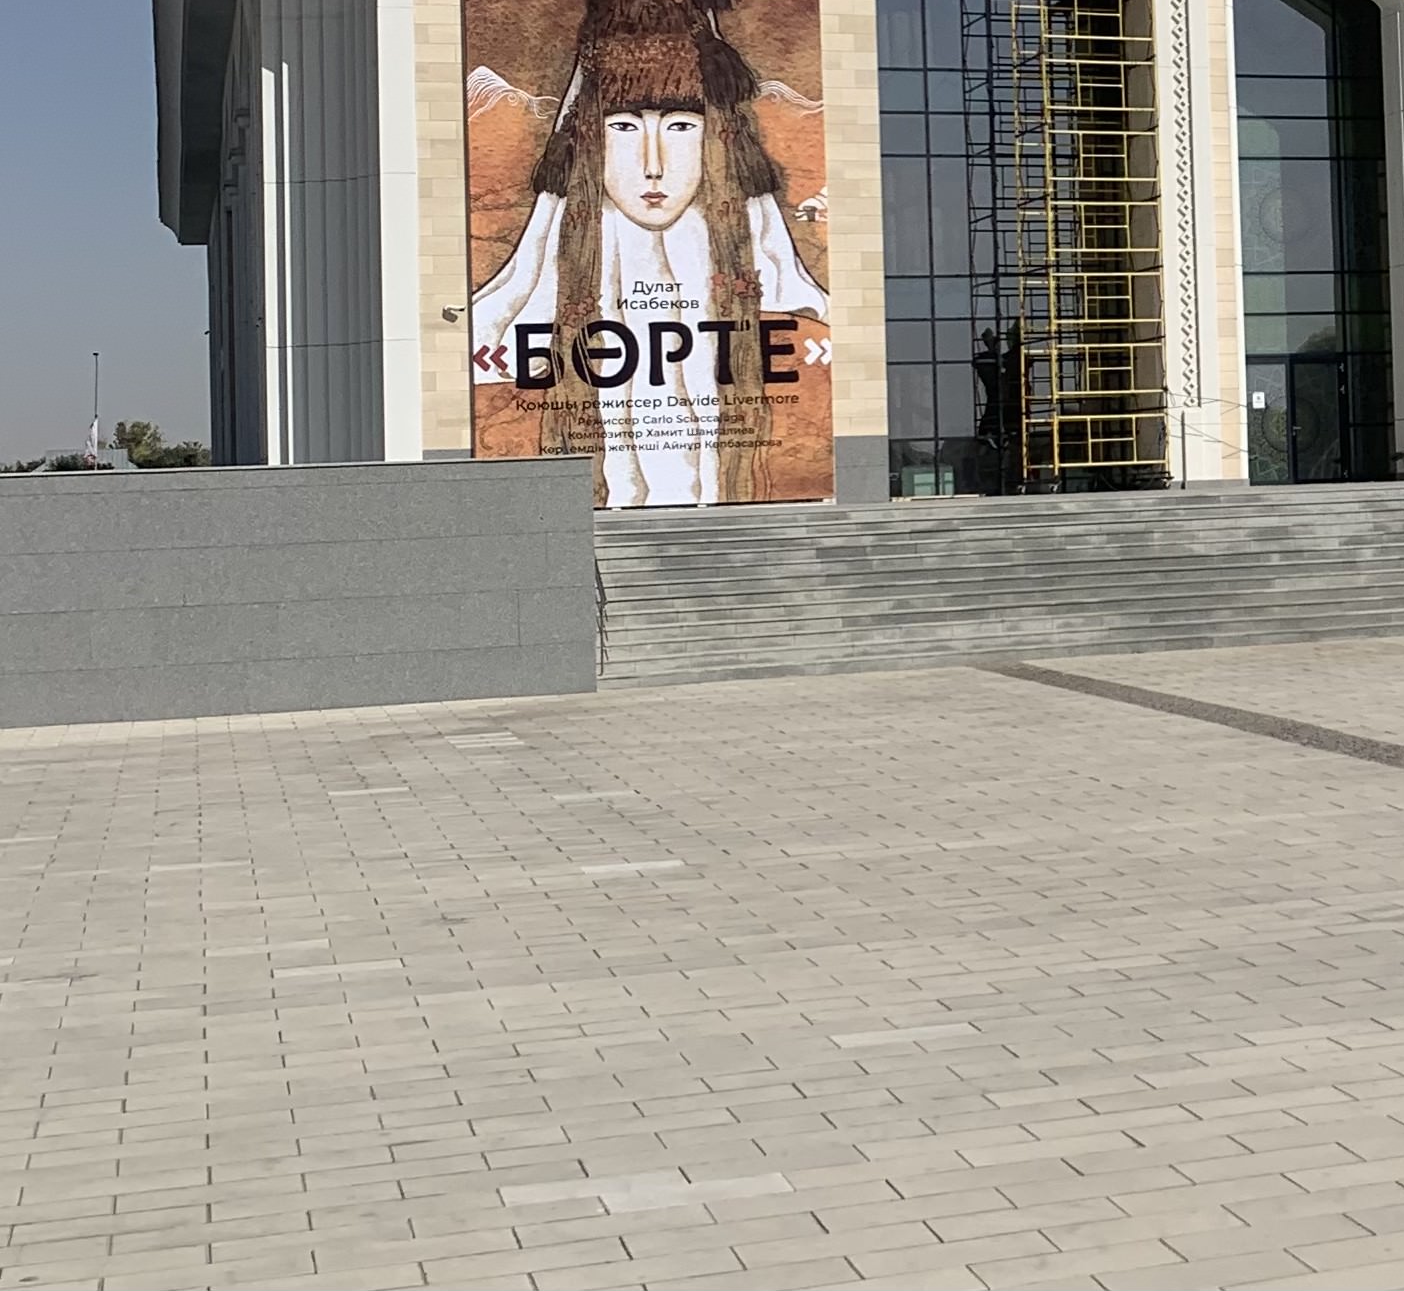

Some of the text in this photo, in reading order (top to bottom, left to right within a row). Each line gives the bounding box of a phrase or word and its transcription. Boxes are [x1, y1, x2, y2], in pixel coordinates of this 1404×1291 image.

[632, 280, 683, 295] Дулат
[617, 297, 700, 310] Исабеков
[516, 394, 800, 413] Қоюшы режиссер Davide Livermore
[643, 414, 673, 425] Carlo
[568, 429, 643, 440] Композитор
[646, 429, 683, 438] Хамит
[541, 444, 605, 455] Көремдік
[608, 443, 659, 452] жетекші
